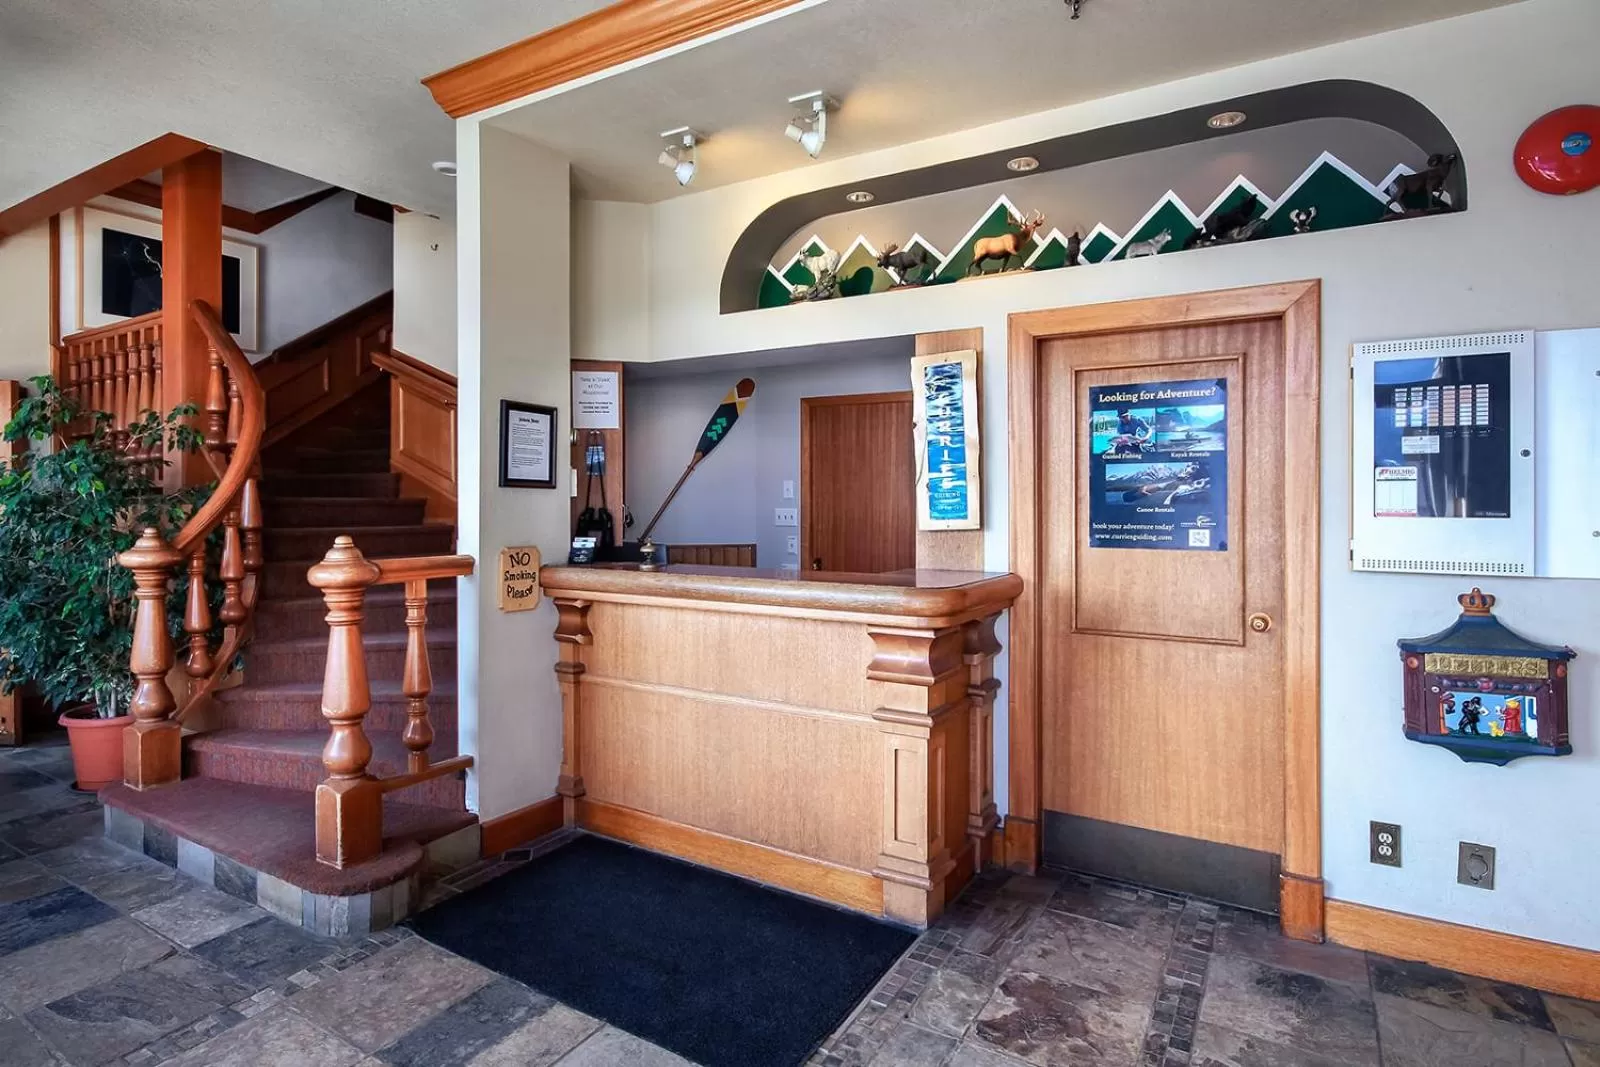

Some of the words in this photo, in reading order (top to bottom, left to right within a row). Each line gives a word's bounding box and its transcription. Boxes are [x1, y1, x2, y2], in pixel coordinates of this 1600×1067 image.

[1099, 391, 1138, 403] Looking
[1140, 390, 1155, 400] for
[1156, 387, 1216, 399] Adventure?
[1155, 523, 1174, 531] today!
[509, 552, 531, 568] NO
[504, 570, 536, 582] Smoking
[507, 584, 533, 598] Please
[1434, 656, 1538, 676] LETTERS
